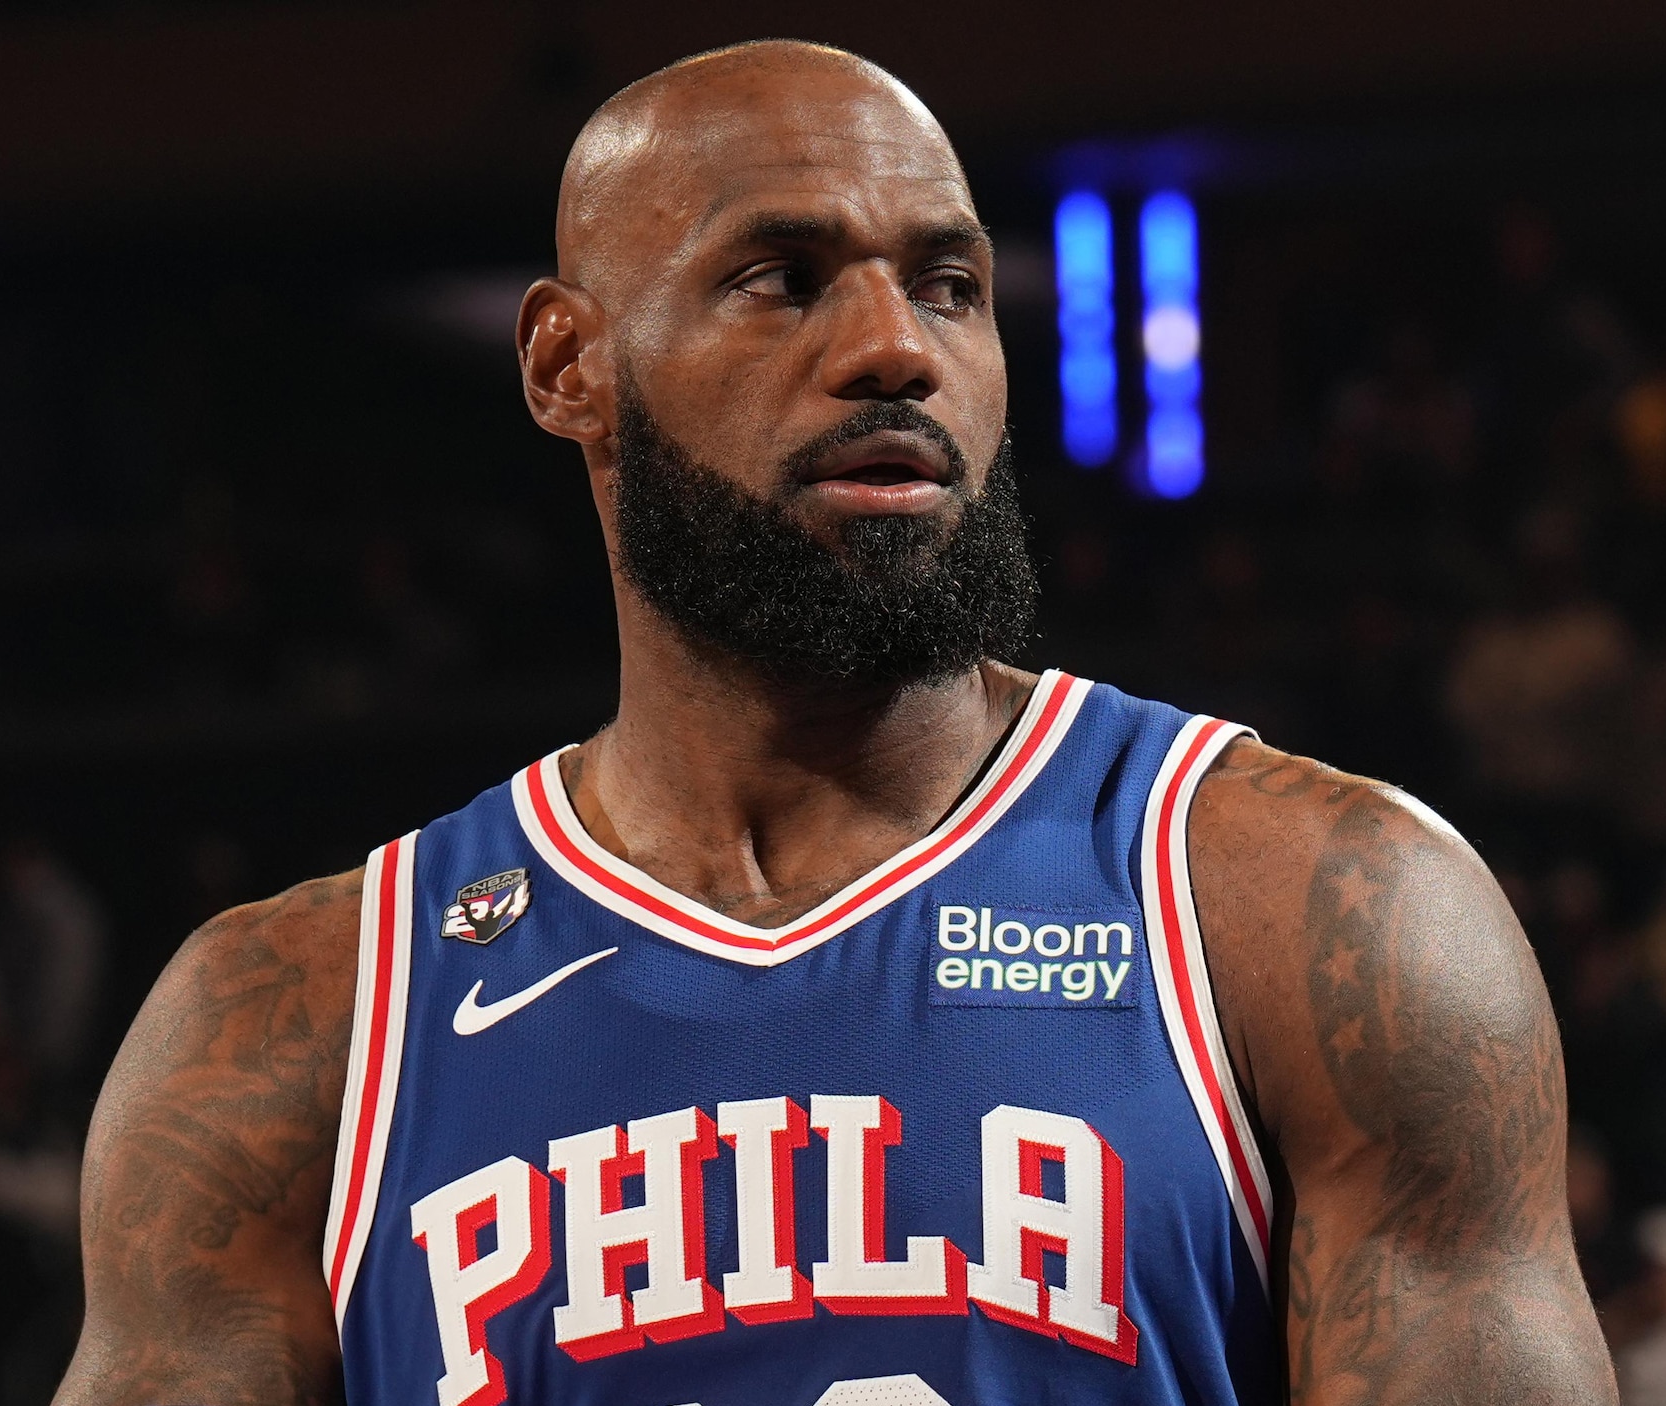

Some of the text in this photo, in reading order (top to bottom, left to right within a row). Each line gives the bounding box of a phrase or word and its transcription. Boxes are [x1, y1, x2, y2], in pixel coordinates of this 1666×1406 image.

[460, 874, 522, 900] SEASONS
[472, 873, 514, 892] NBA
[938, 905, 1133, 957] Bloom
[936, 957, 1132, 1001] energy
